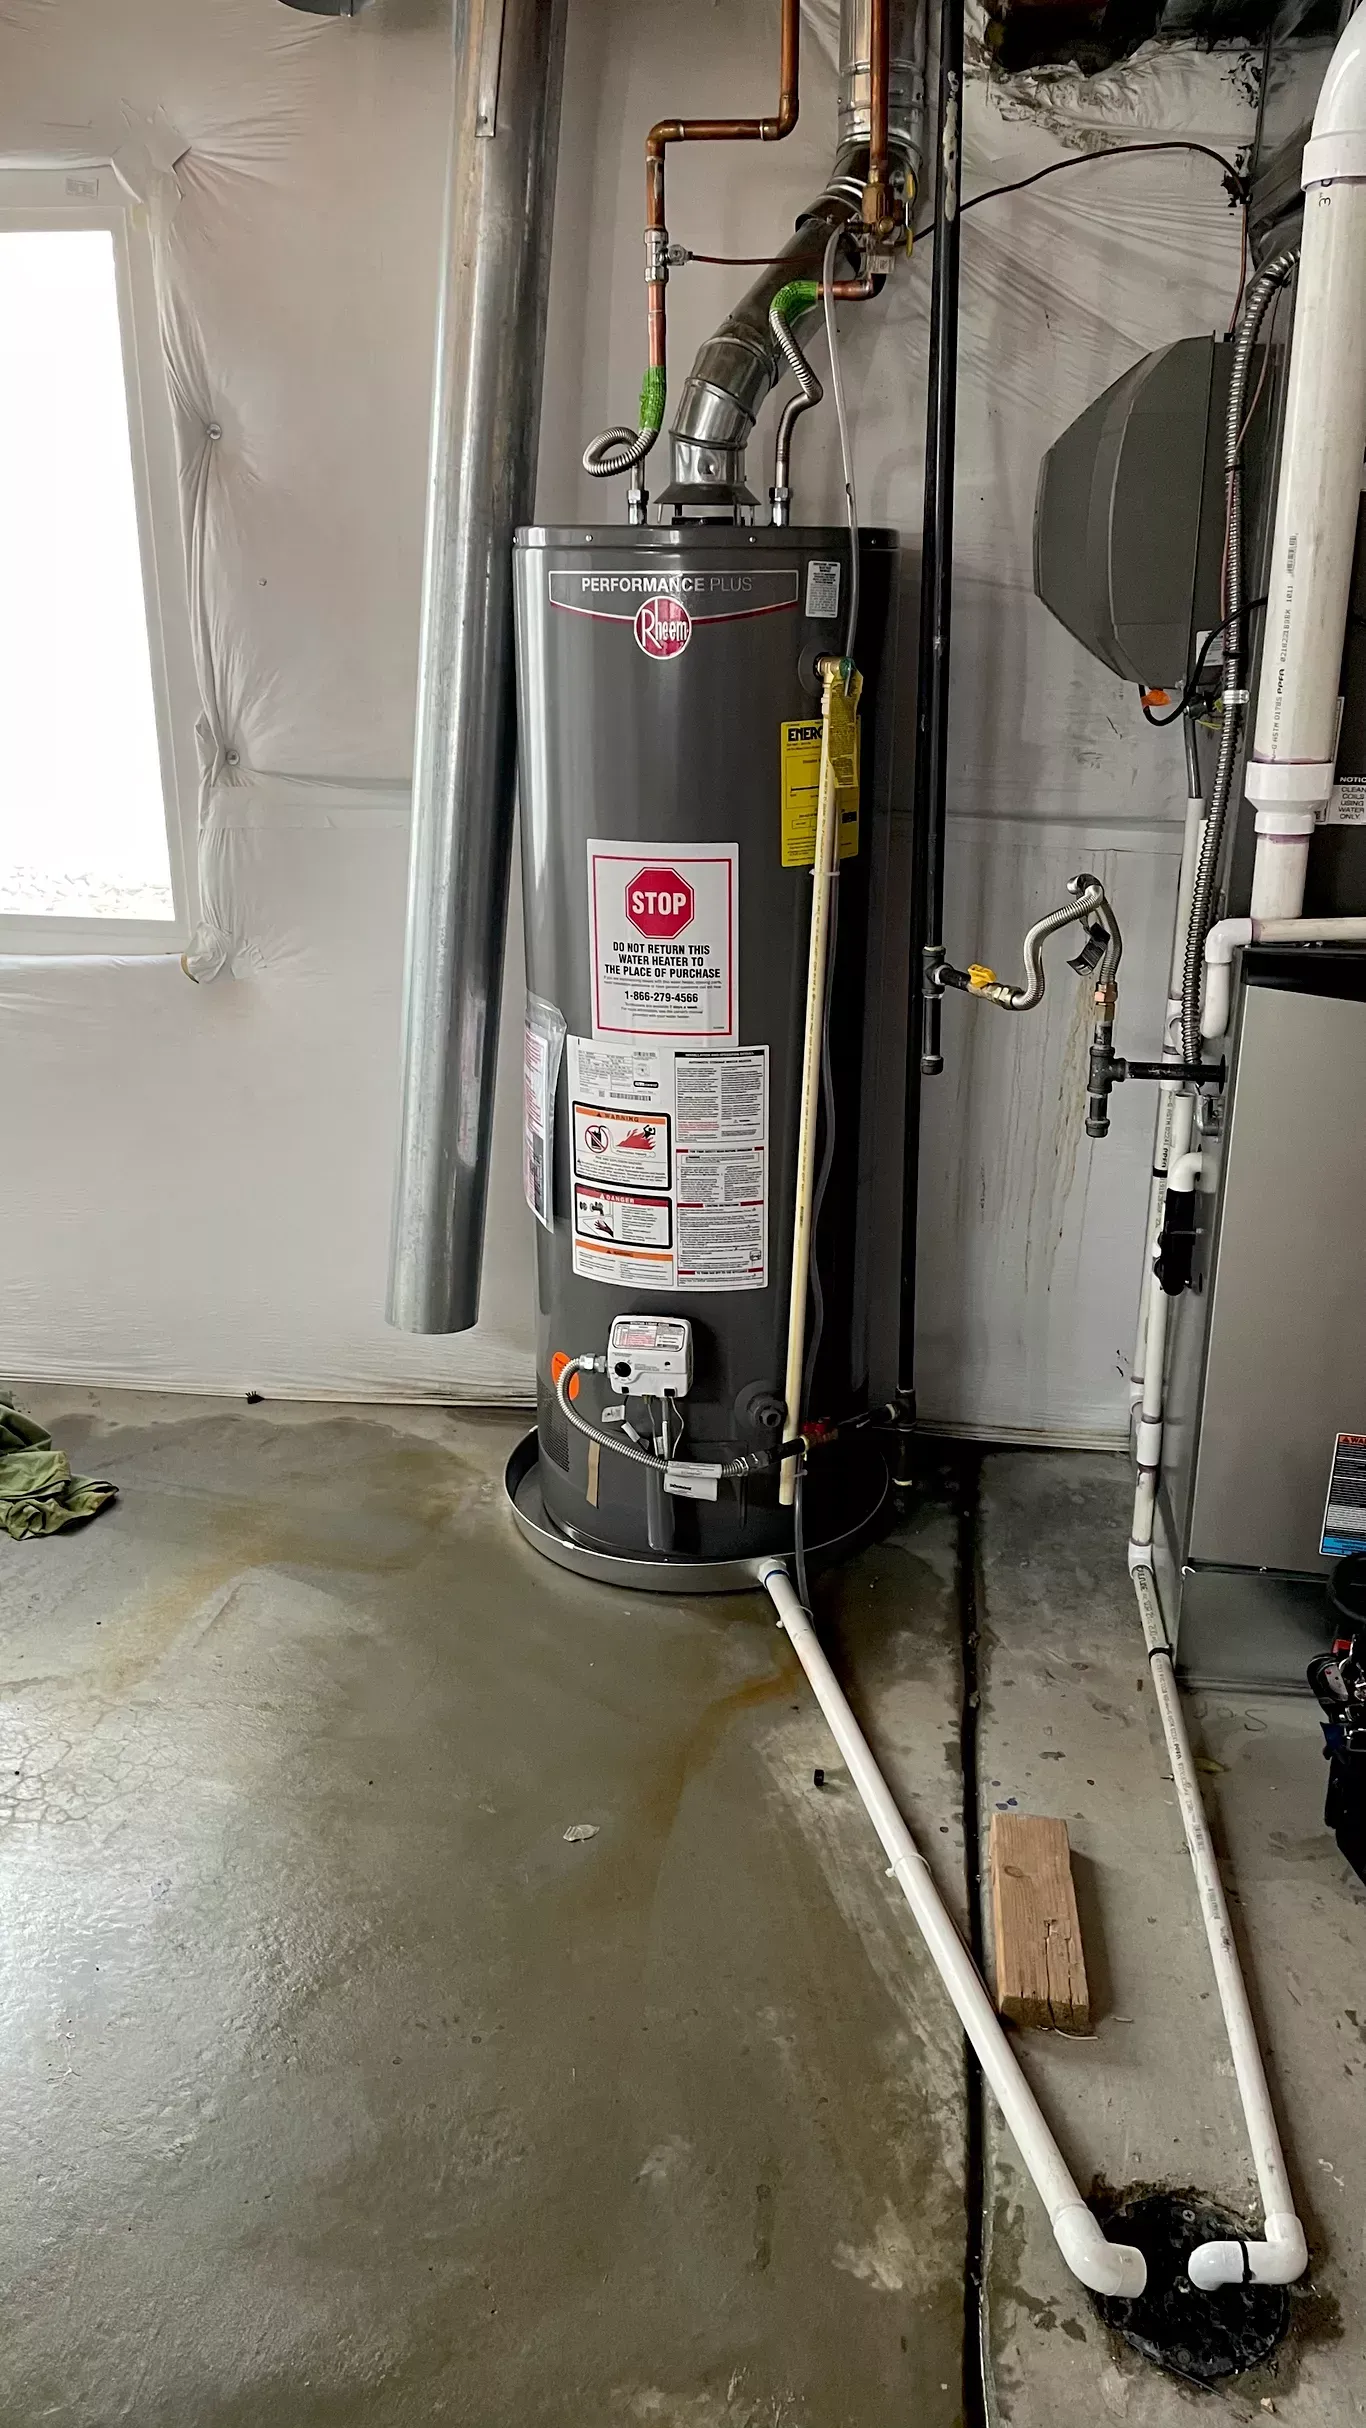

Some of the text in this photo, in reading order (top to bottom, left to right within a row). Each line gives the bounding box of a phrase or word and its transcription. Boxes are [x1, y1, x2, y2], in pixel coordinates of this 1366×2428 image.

[582, 577, 752, 593] PERFORMANCE PLUS
[641, 607, 690, 650] Rheem
[632, 891, 687, 916] STOP
[613, 941, 710, 955] DO NOT RETURN THIS
[619, 953, 704, 966] WATER HEATER TO
[605, 964, 721, 979] THE PLACE OF PURCHASE
[624, 990, 699, 1003] 1-866-279-4566
[605, 1112, 639, 1122] WARNING
[606, 1194, 635, 1203] DANGER
